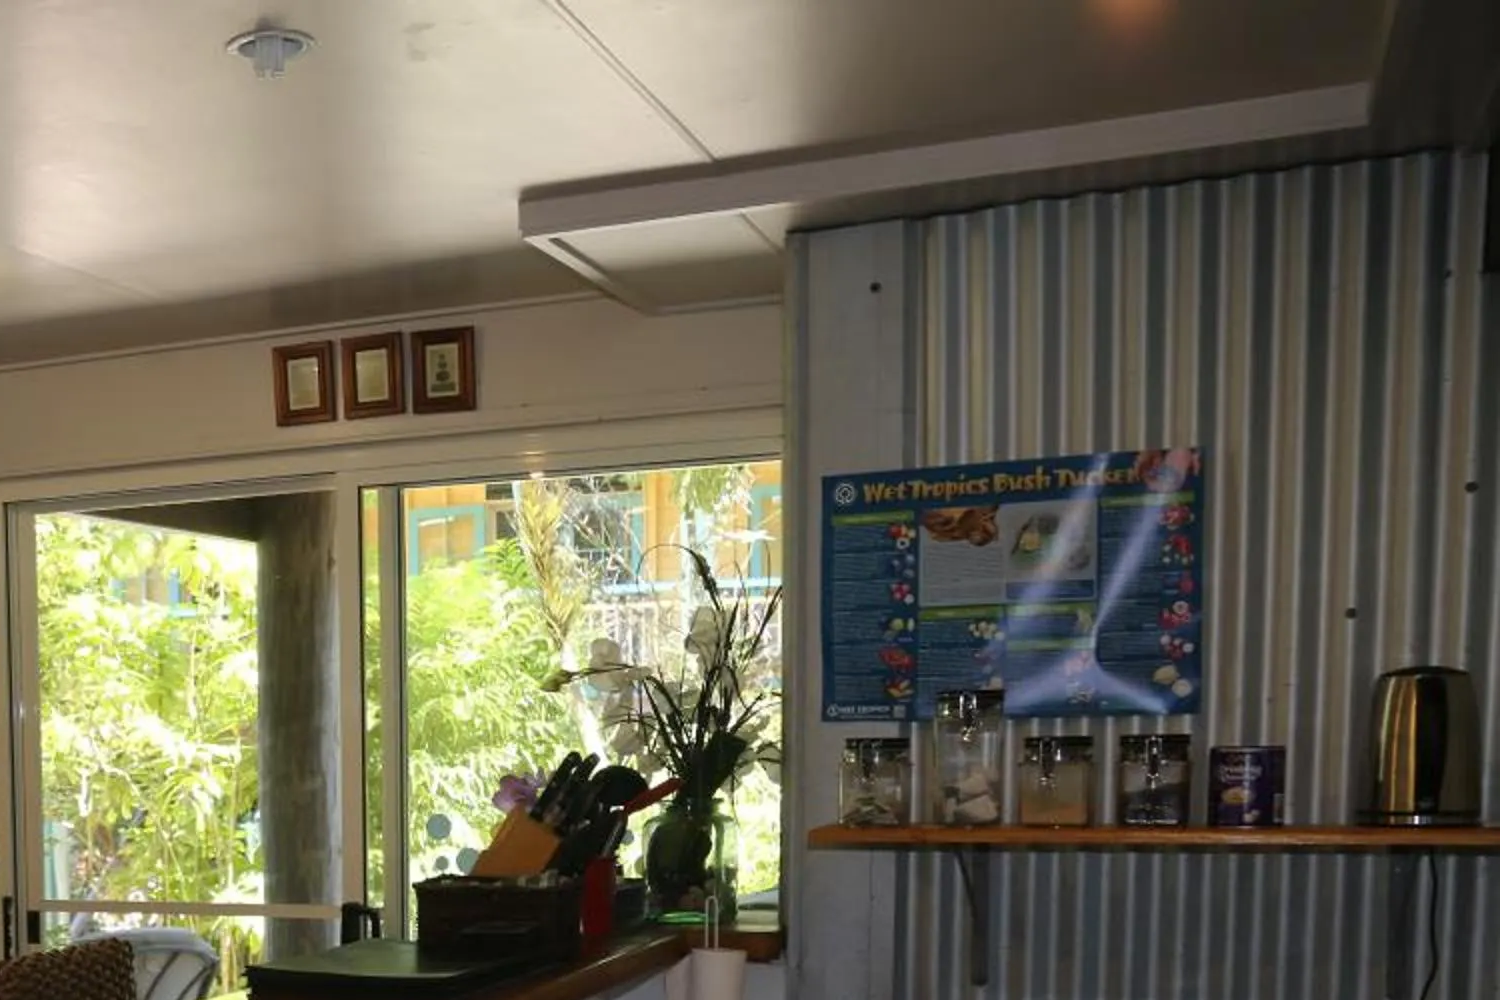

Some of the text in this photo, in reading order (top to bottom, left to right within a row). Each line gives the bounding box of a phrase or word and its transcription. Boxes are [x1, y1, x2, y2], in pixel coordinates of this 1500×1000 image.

[863, 480, 906, 504] Wet
[906, 473, 990, 501] Tropics
[993, 466, 1051, 493] Bush
